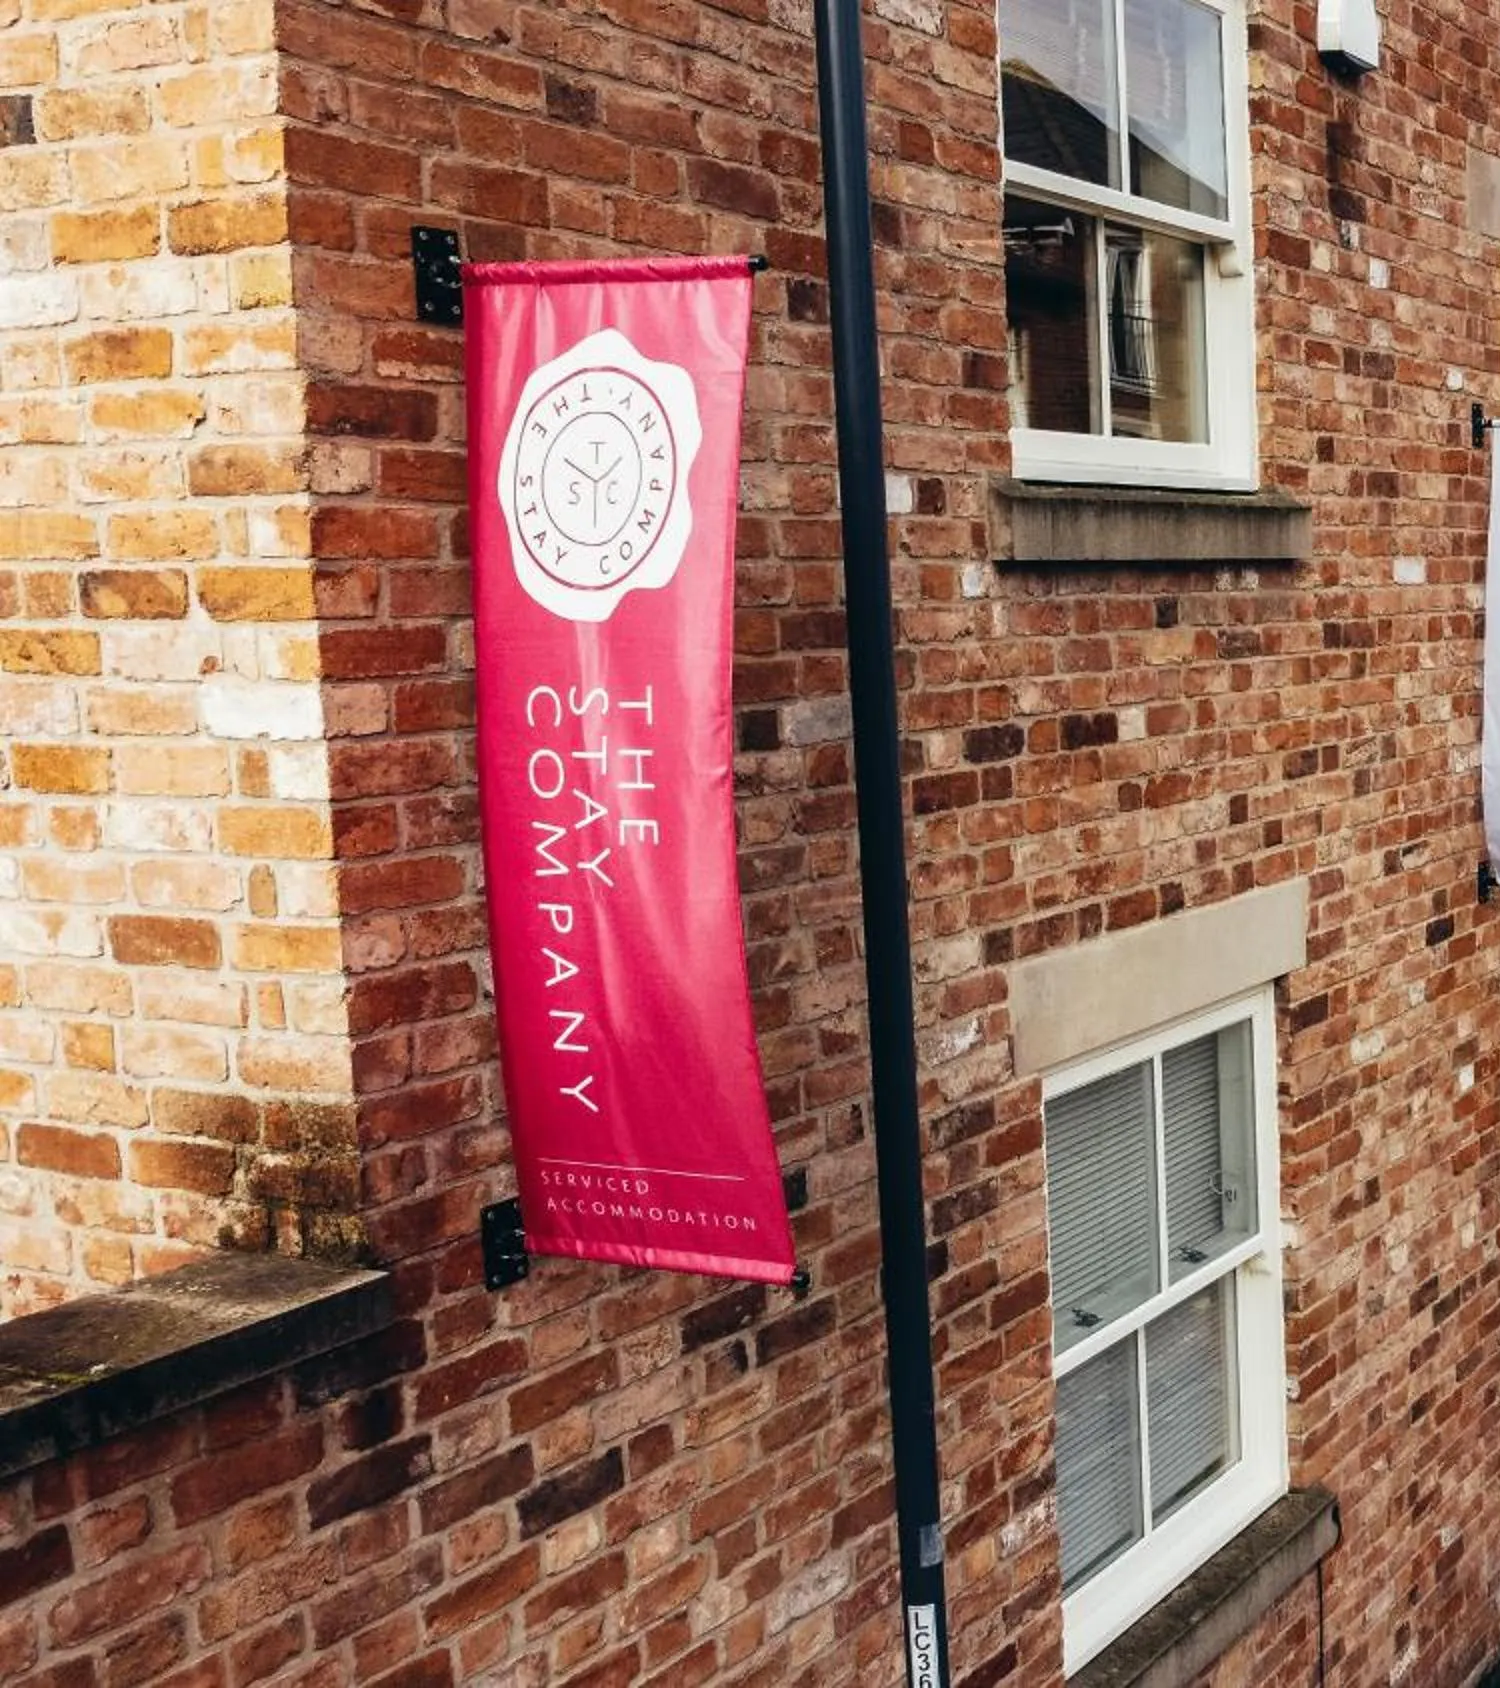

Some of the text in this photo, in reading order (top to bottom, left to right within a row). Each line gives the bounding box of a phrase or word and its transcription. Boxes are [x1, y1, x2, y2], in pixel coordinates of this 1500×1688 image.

[520, 383, 666, 576] THE STAY COMPANY
[568, 685, 615, 888] STAY
[617, 685, 660, 846] THE
[526, 685, 599, 1113] COMPANY
[541, 1170, 650, 1195] SERVICED
[547, 1197, 757, 1231] ACCOMMODATION
